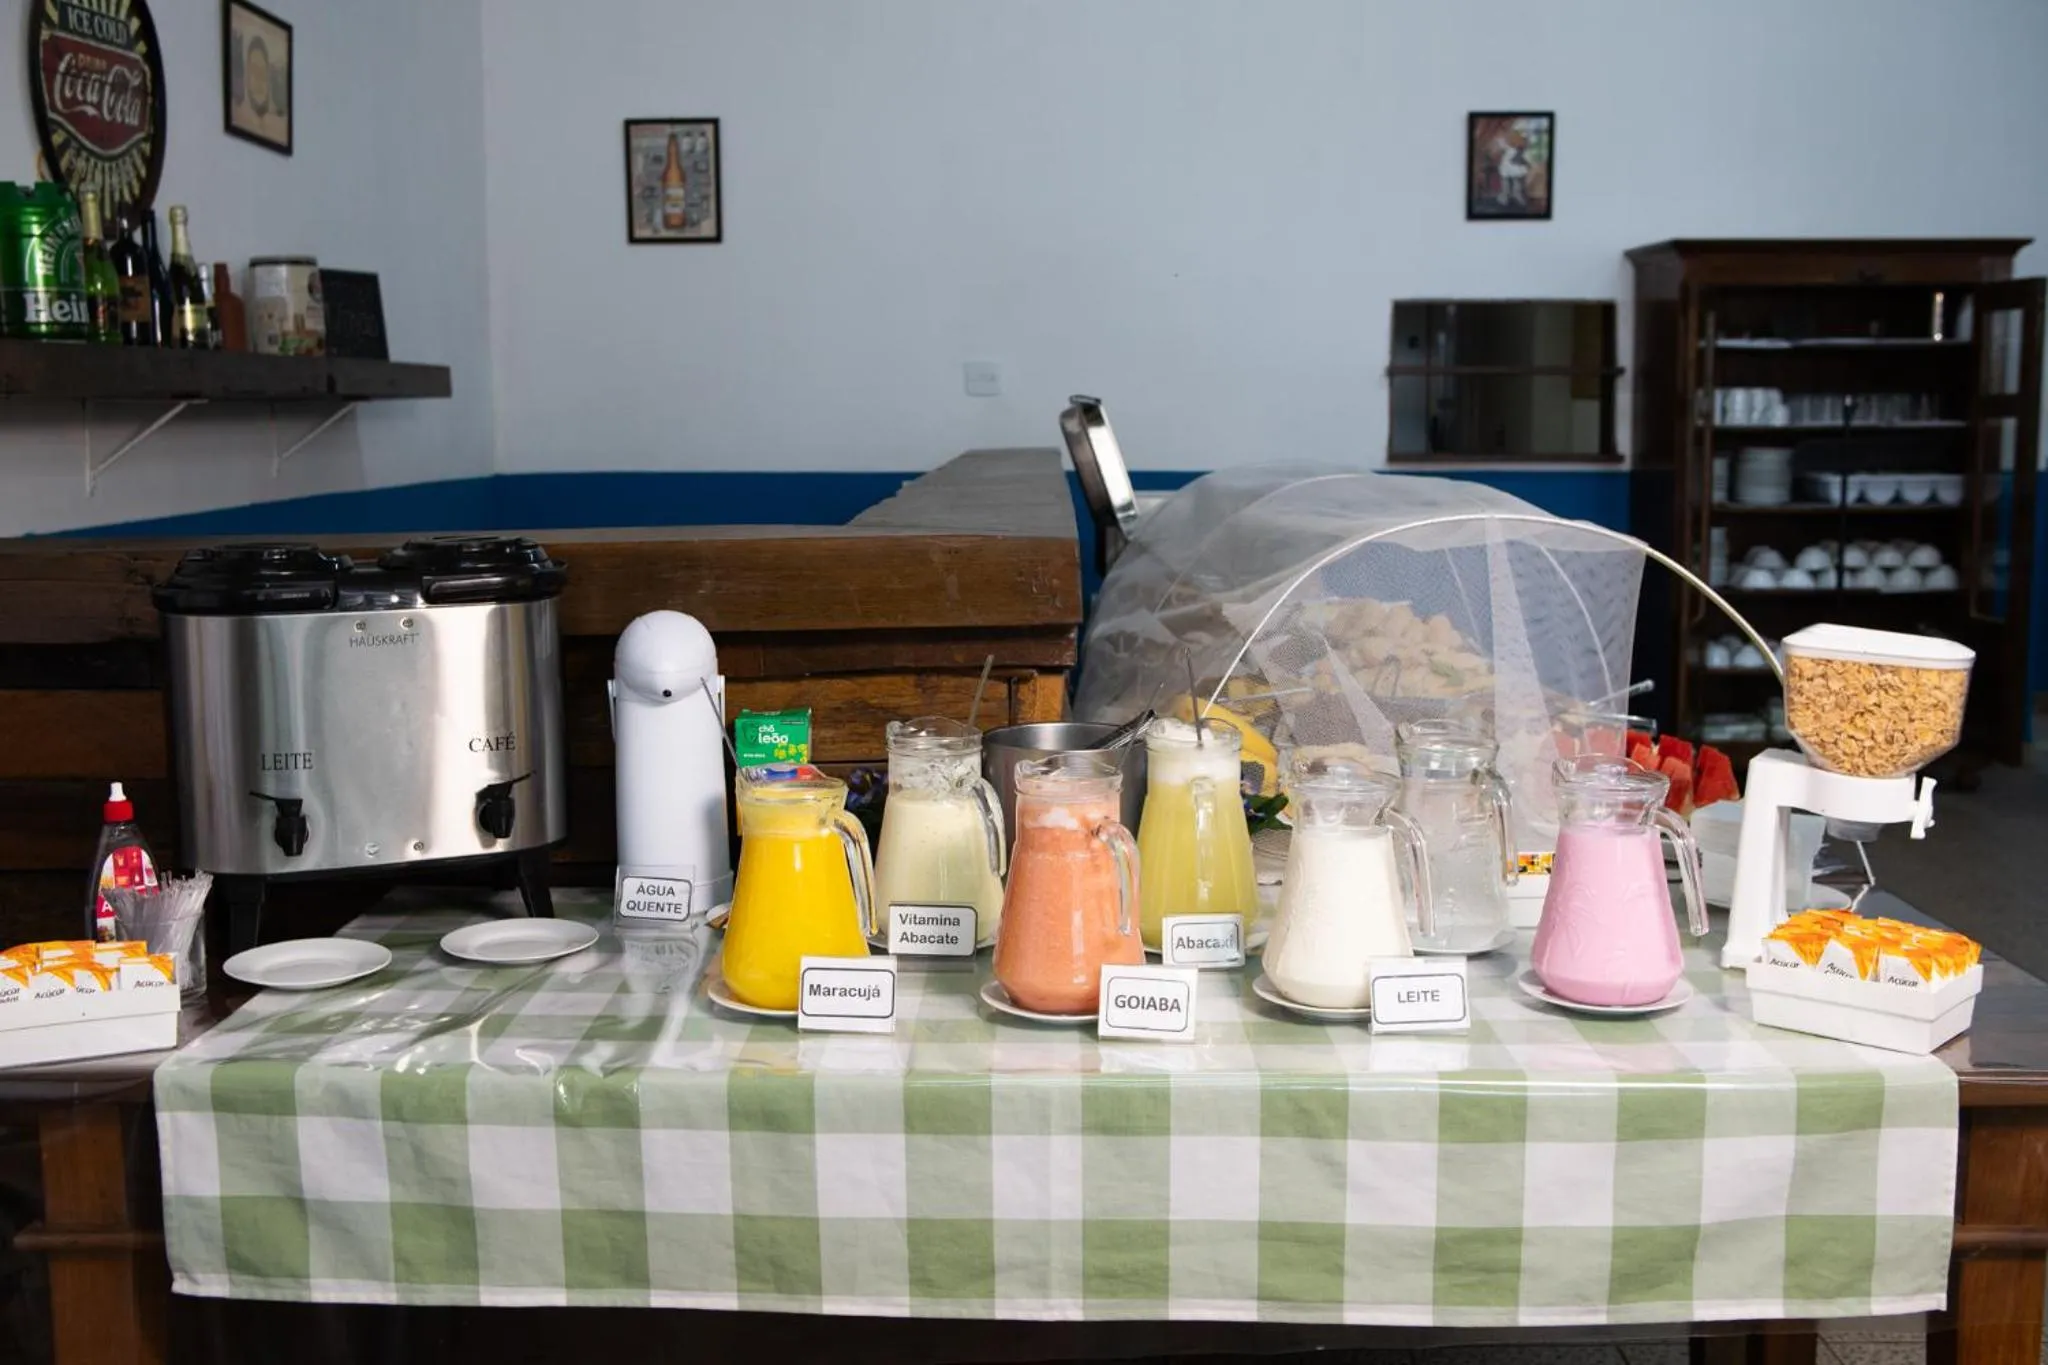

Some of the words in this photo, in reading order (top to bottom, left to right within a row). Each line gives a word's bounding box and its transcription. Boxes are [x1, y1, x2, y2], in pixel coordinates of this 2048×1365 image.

[67, 6, 93, 35] ICE
[93, 15, 128, 44] COLD
[468, 732, 516, 753] CAFÉ
[260, 752, 314, 771] LEITE
[636, 881, 675, 897] ÁGUA
[626, 900, 683, 914] QUENTE
[899, 913, 960, 927] Vitamina
[899, 931, 959, 945] Abacate
[808, 983, 881, 1001] Maracujá
[1397, 989, 1441, 1004] LEITE
[1114, 994, 1181, 1013] GOIABA
